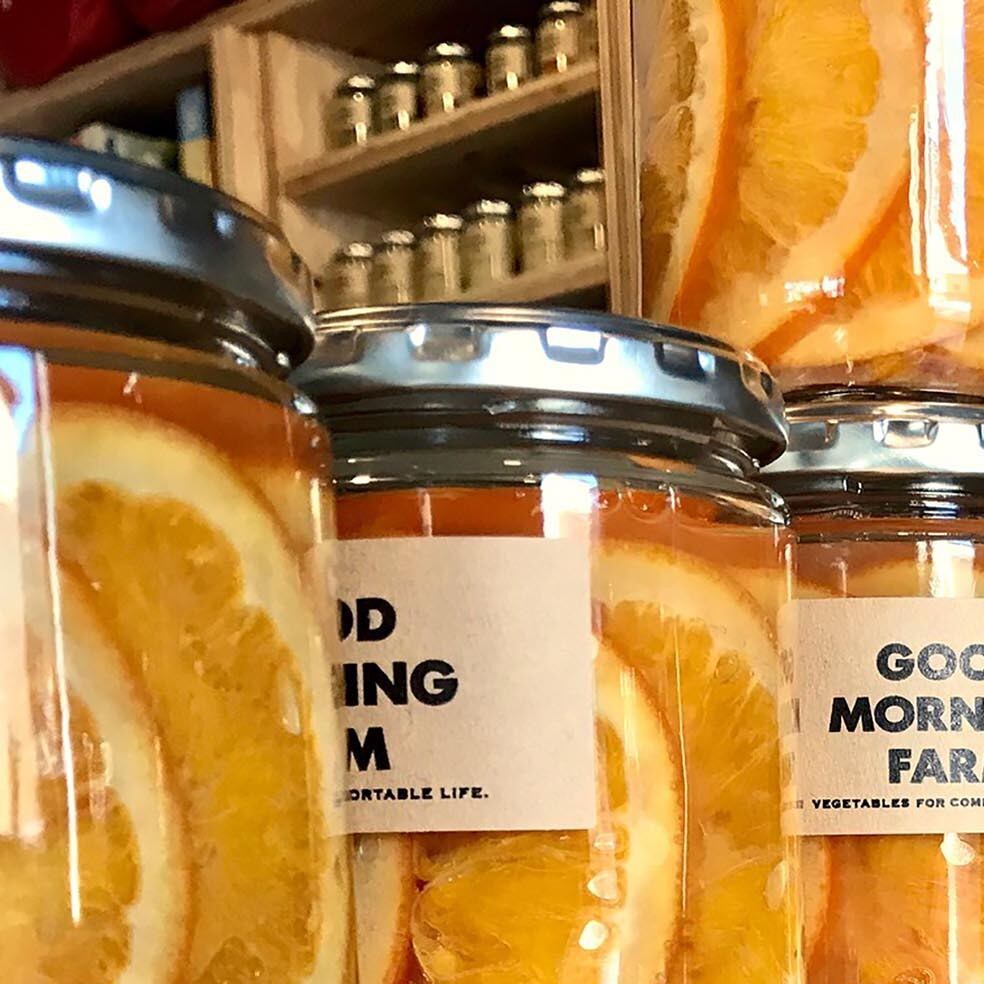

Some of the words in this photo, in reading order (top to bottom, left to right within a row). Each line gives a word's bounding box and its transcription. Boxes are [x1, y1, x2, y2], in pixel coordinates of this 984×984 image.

[440, 786, 489, 799] LIFE.
[812, 797, 910, 809] VEGETABLES
[916, 798, 945, 808] FOR
